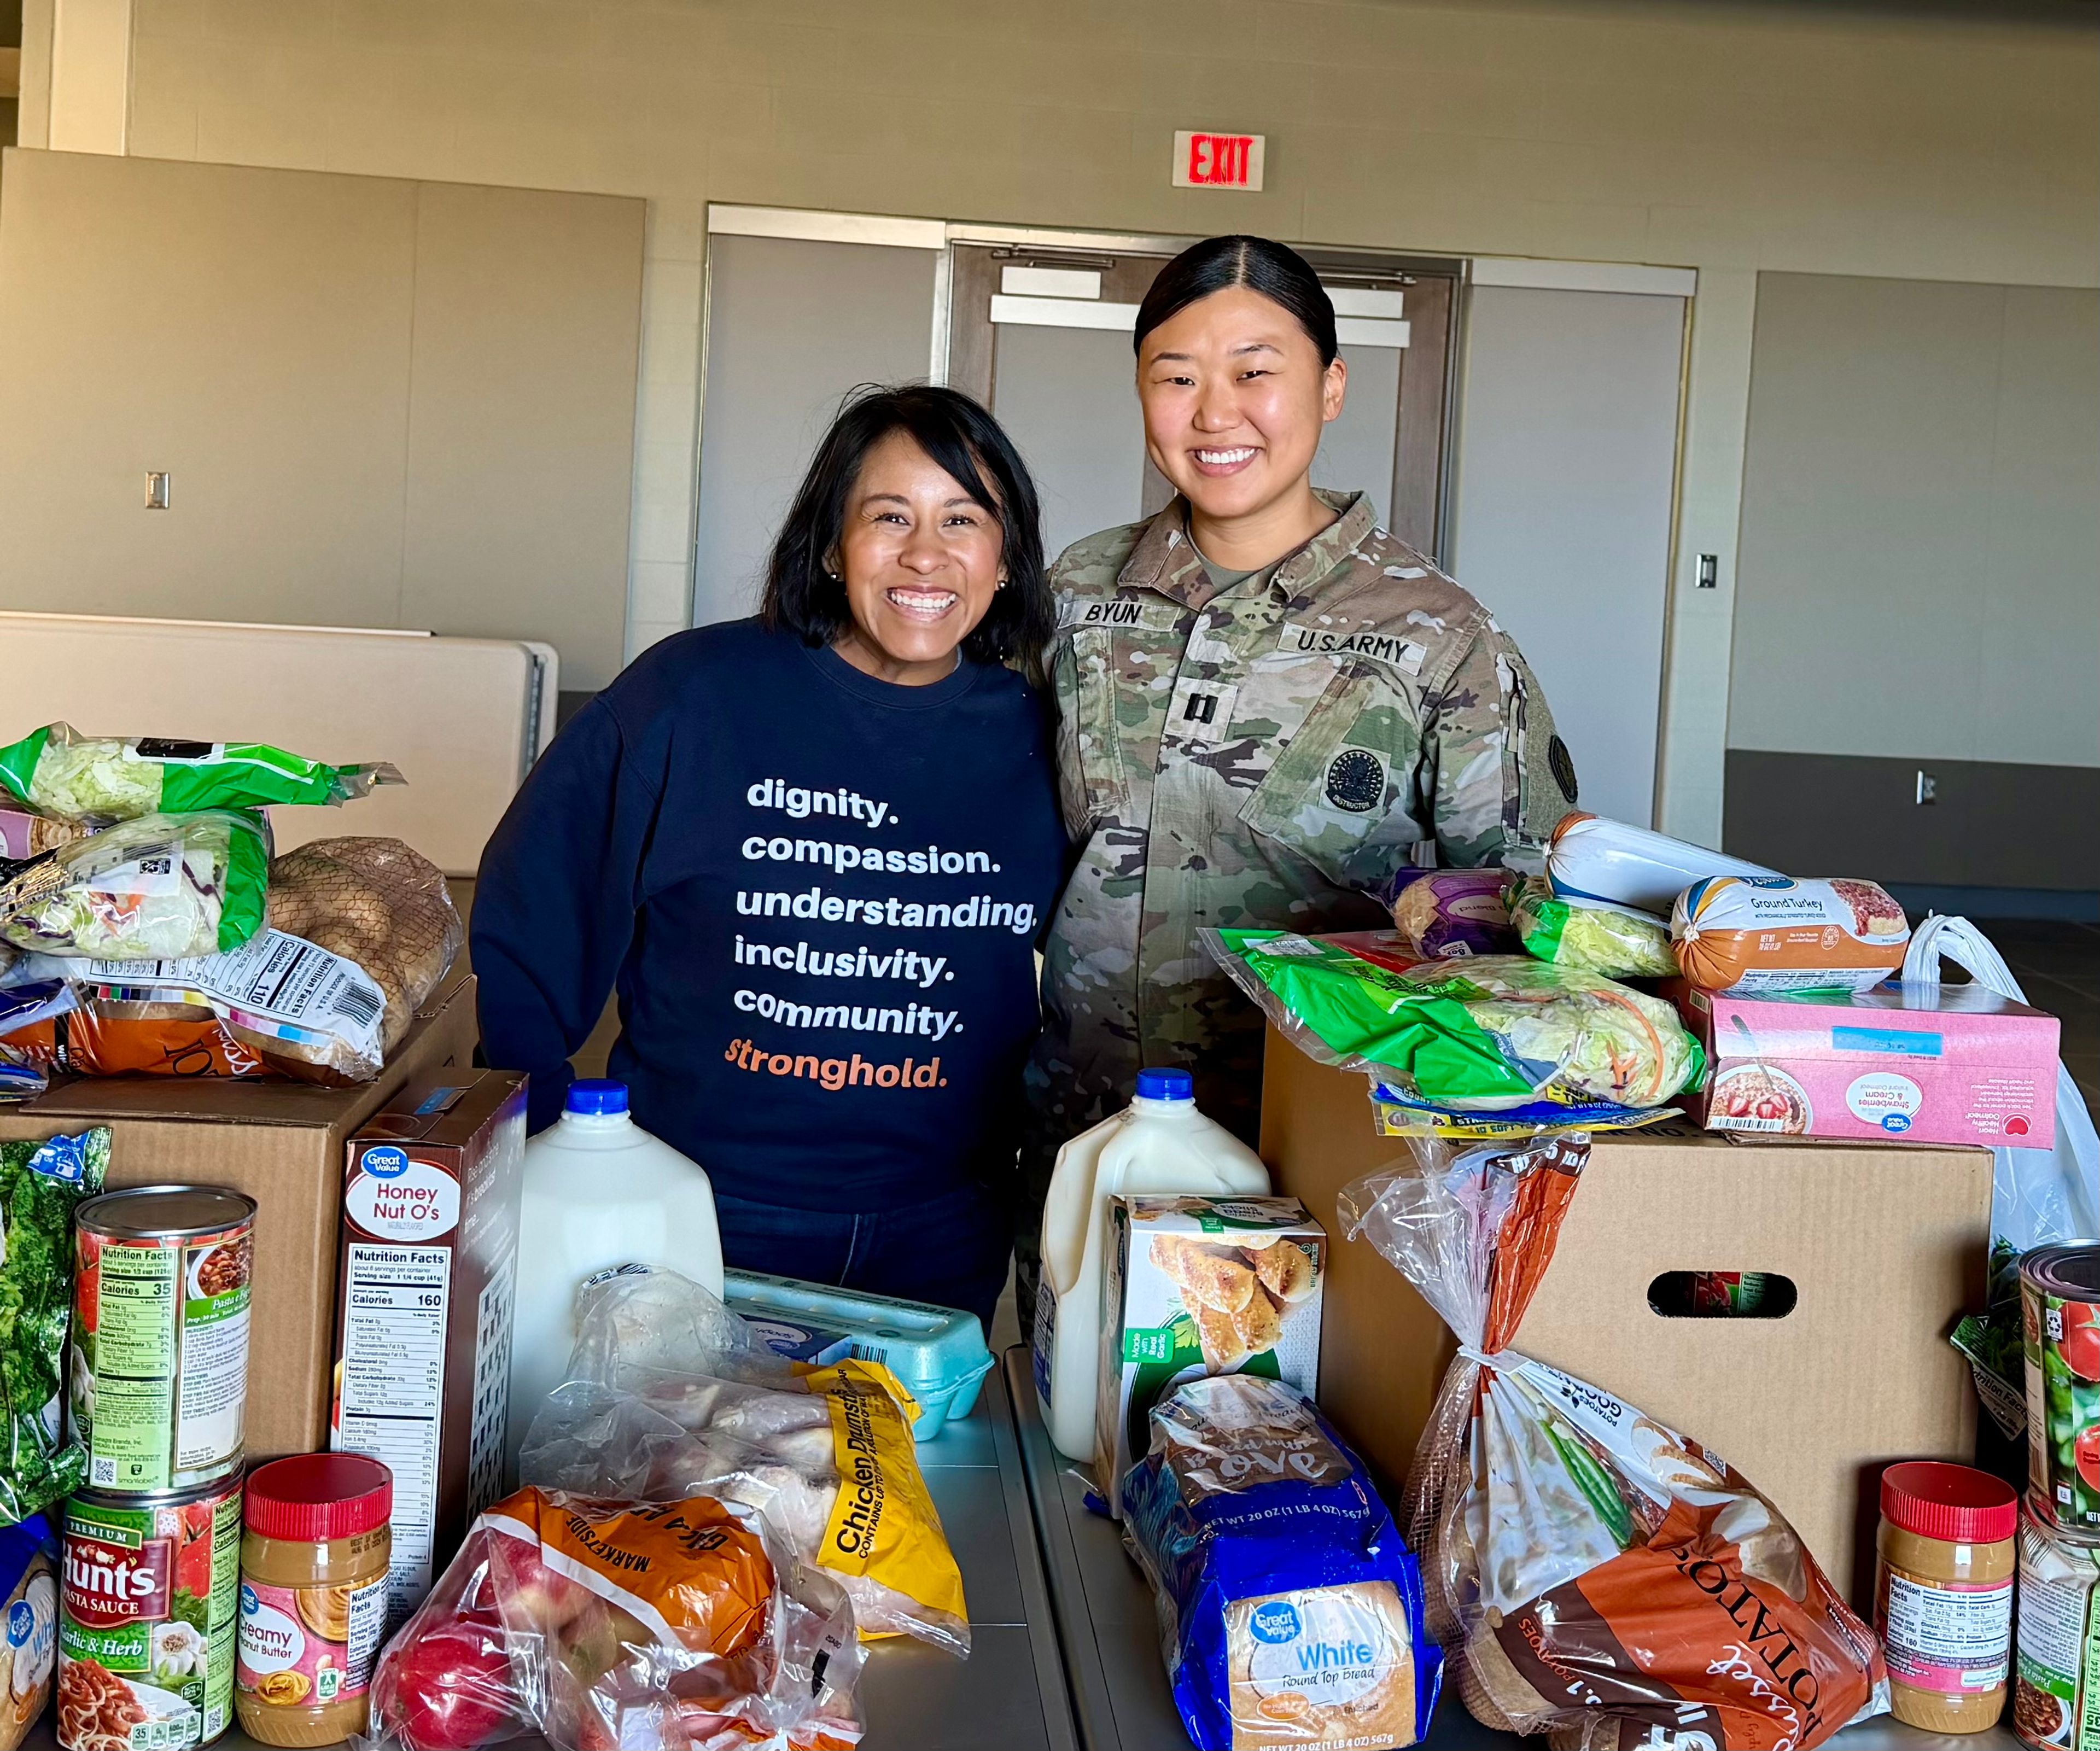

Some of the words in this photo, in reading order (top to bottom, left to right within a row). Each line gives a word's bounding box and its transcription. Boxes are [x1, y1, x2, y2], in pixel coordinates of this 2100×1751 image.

[1189, 133, 1254, 185] EXIT
[1085, 603, 1142, 624] BYUN
[747, 779, 898, 827] dignity.
[742, 836, 1000, 873] compassion.
[1751, 898, 1790, 910] Ground
[1792, 898, 1822, 911] Turkey
[267, 942, 295, 973] Calories
[734, 935, 954, 987] inclusivity.
[308, 958, 335, 989] Nutrition
[251, 985, 270, 1005] 110
[291, 989, 312, 1014] Facts
[734, 989, 964, 1041] community.
[725, 1038, 948, 1090] stronghold.
[1858, 1099, 1909, 1108] Strawberries
[1865, 1091, 1895, 1100] Cream
[1491, 1124, 1514, 1133] SOFT
[1887, 1121, 1909, 1129] Great
[1971, 1119, 2000, 1128] Healthy
[368, 1153, 400, 1166] Great
[375, 1163, 400, 1173] Value
[377, 1183, 438, 1203] Honey
[373, 1203, 405, 1219] Nut
[411, 1204, 440, 1221] O's
[102, 1247, 142, 1259] Nutrition
[145, 1251, 173, 1260] Facts
[355, 1250, 407, 1262] Nutrition
[411, 1252, 445, 1264] Facts
[354, 1272, 377, 1280] Serving
[101, 1282, 140, 1295] Calories
[153, 1283, 172, 1295] 35
[212, 1297, 235, 1310] Pasta
[352, 1294, 393, 1305] Calories
[417, 1294, 441, 1306] 160
[1131, 1333, 1140, 1358] Made
[1148, 1336, 1157, 1356] Real
[1157, 1333, 1166, 1359] Garlic
[1578, 1395, 1618, 1427] POTATOES
[836, 1456, 876, 1554] Chicken
[859, 1501, 884, 1559] CONTAINS
[877, 1485, 884, 1501] UP
[1204, 1518, 1223, 1531] NET
[1226, 1515, 1245, 1525] WT
[1249, 1513, 1263, 1522] 20
[1264, 1507, 1281, 1519] OZ
[1282, 1506, 1292, 1516] (1
[1297, 1504, 1310, 1514] LB
[1313, 1504, 1320, 1512] 4
[1322, 1505, 1341, 1516] OZ)
[71, 1521, 127, 1543] PREMIUM
[351, 1585, 380, 1603] Nutrition
[1891, 1577, 1921, 1597] Nutrition
[1891, 1587, 1908, 1602] Facts
[90, 1598, 139, 1615] SAUCE
[351, 1602, 371, 1615] Facts
[1255, 1610, 1294, 1628] Great
[88, 1637, 99, 1653] &
[101, 1639, 143, 1656] Herb
[261, 1644, 292, 1659] Butter
[1296, 1639, 1374, 1671] White
[1283, 1671, 1319, 1688] Round
[1321, 1671, 1339, 1686] Top
[1342, 1664, 1376, 1680] Bread
[135, 1727, 146, 1739] 35
[1295, 1743, 1308, 1751] 20
[1308, 1741, 1322, 1751] OZ
[1322, 1739, 1331, 1750] (1
[1333, 1738, 1345, 1749] LB
[1346, 1738, 1353, 1748] 4
[1354, 1736, 1370, 1747] OZ)
[1370, 1733, 1394, 1744] 567g
